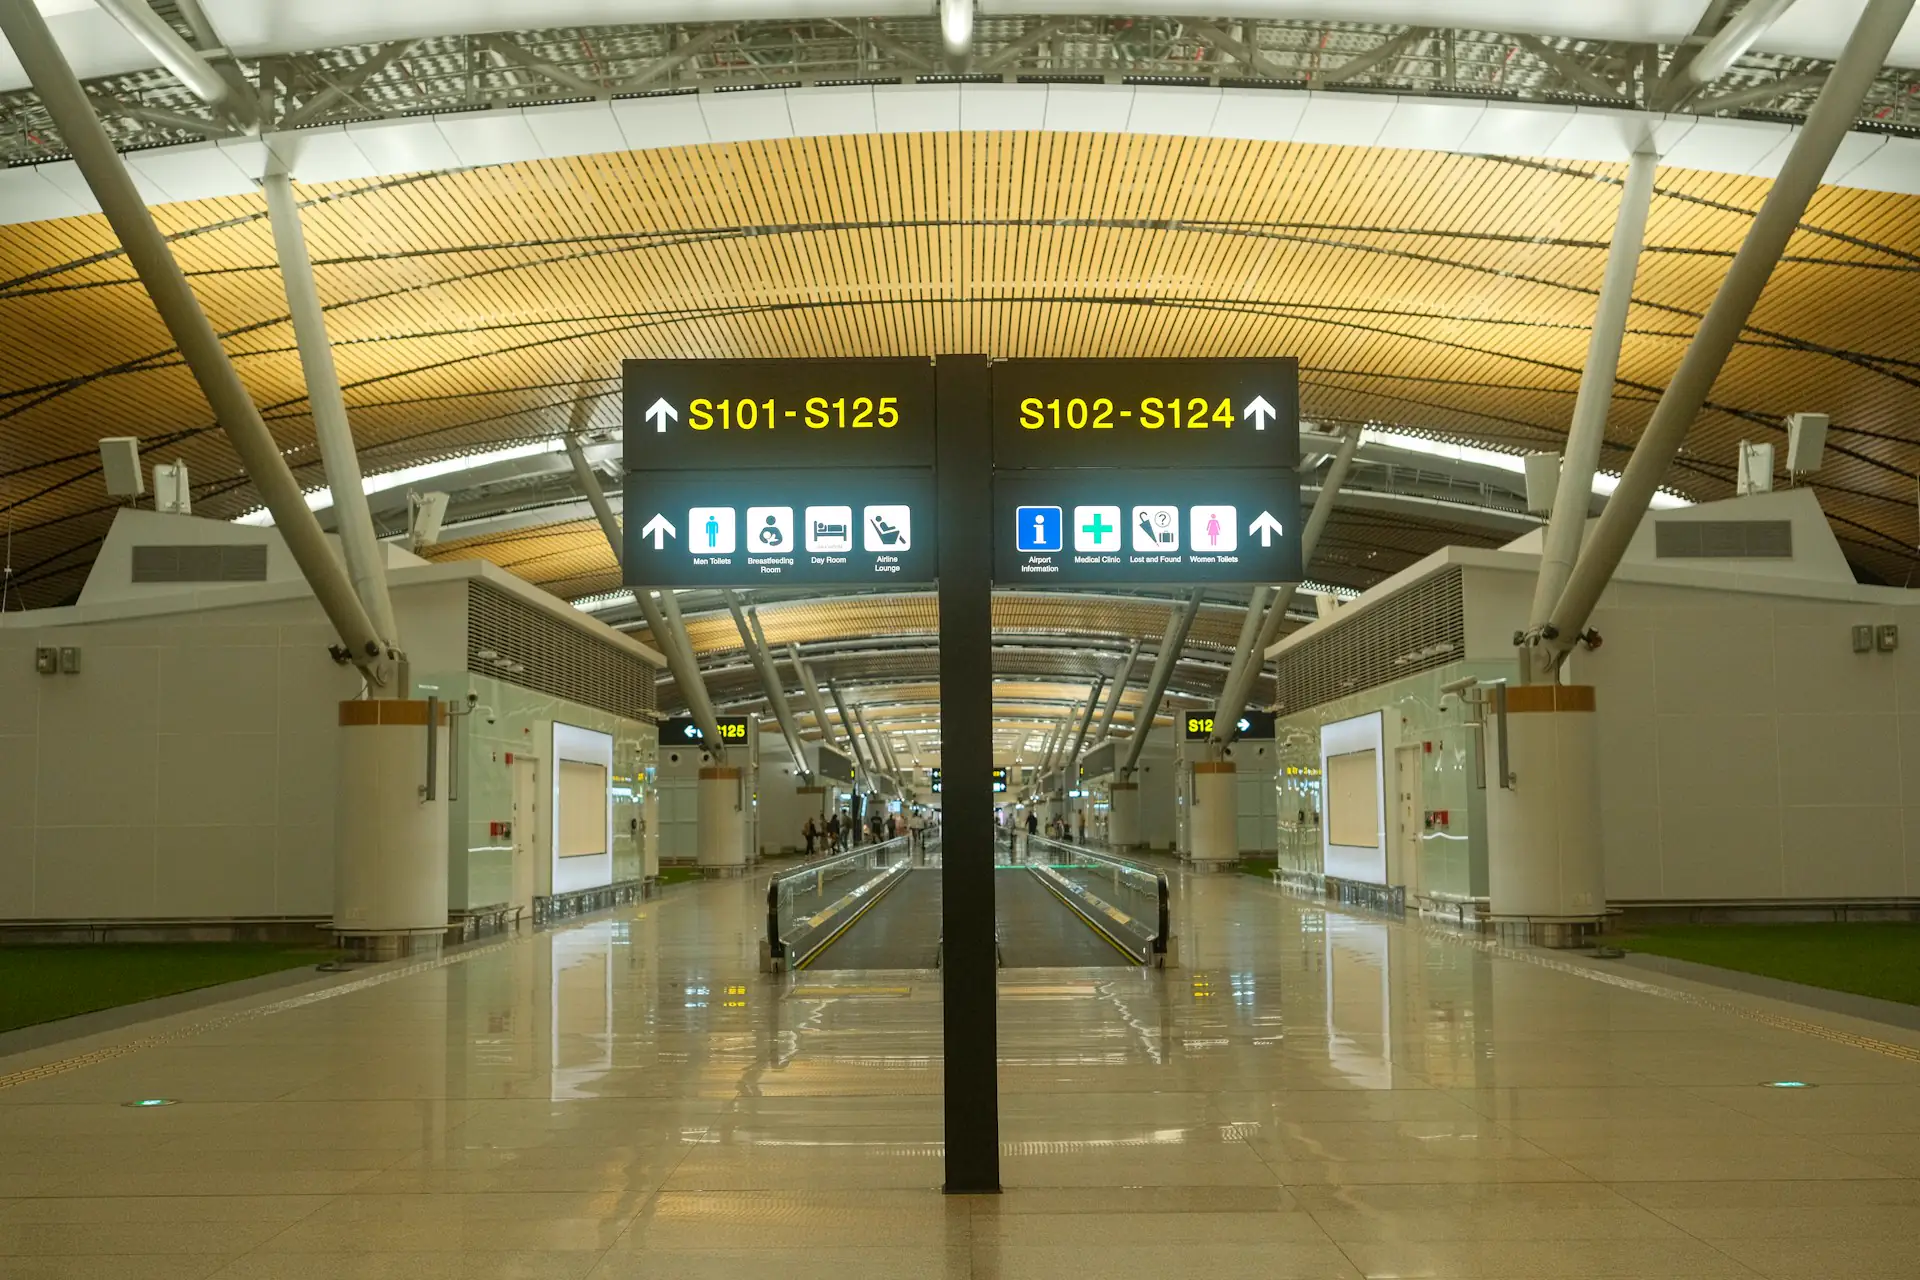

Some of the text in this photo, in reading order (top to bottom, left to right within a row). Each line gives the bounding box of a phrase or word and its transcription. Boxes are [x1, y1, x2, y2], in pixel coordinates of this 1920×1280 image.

[688, 397, 899, 430] S101-S125
[1019, 397, 1236, 430] S102-S124
[710, 557, 732, 565] Toilets
[747, 557, 794, 565] Breastfeeding
[811, 556, 847, 565] Day Room
[1028, 556, 1052, 564] Airport
[874, 565, 901, 573] Lounge
[1021, 565, 1059, 573] Information
[1188, 719, 1214, 732] S12
